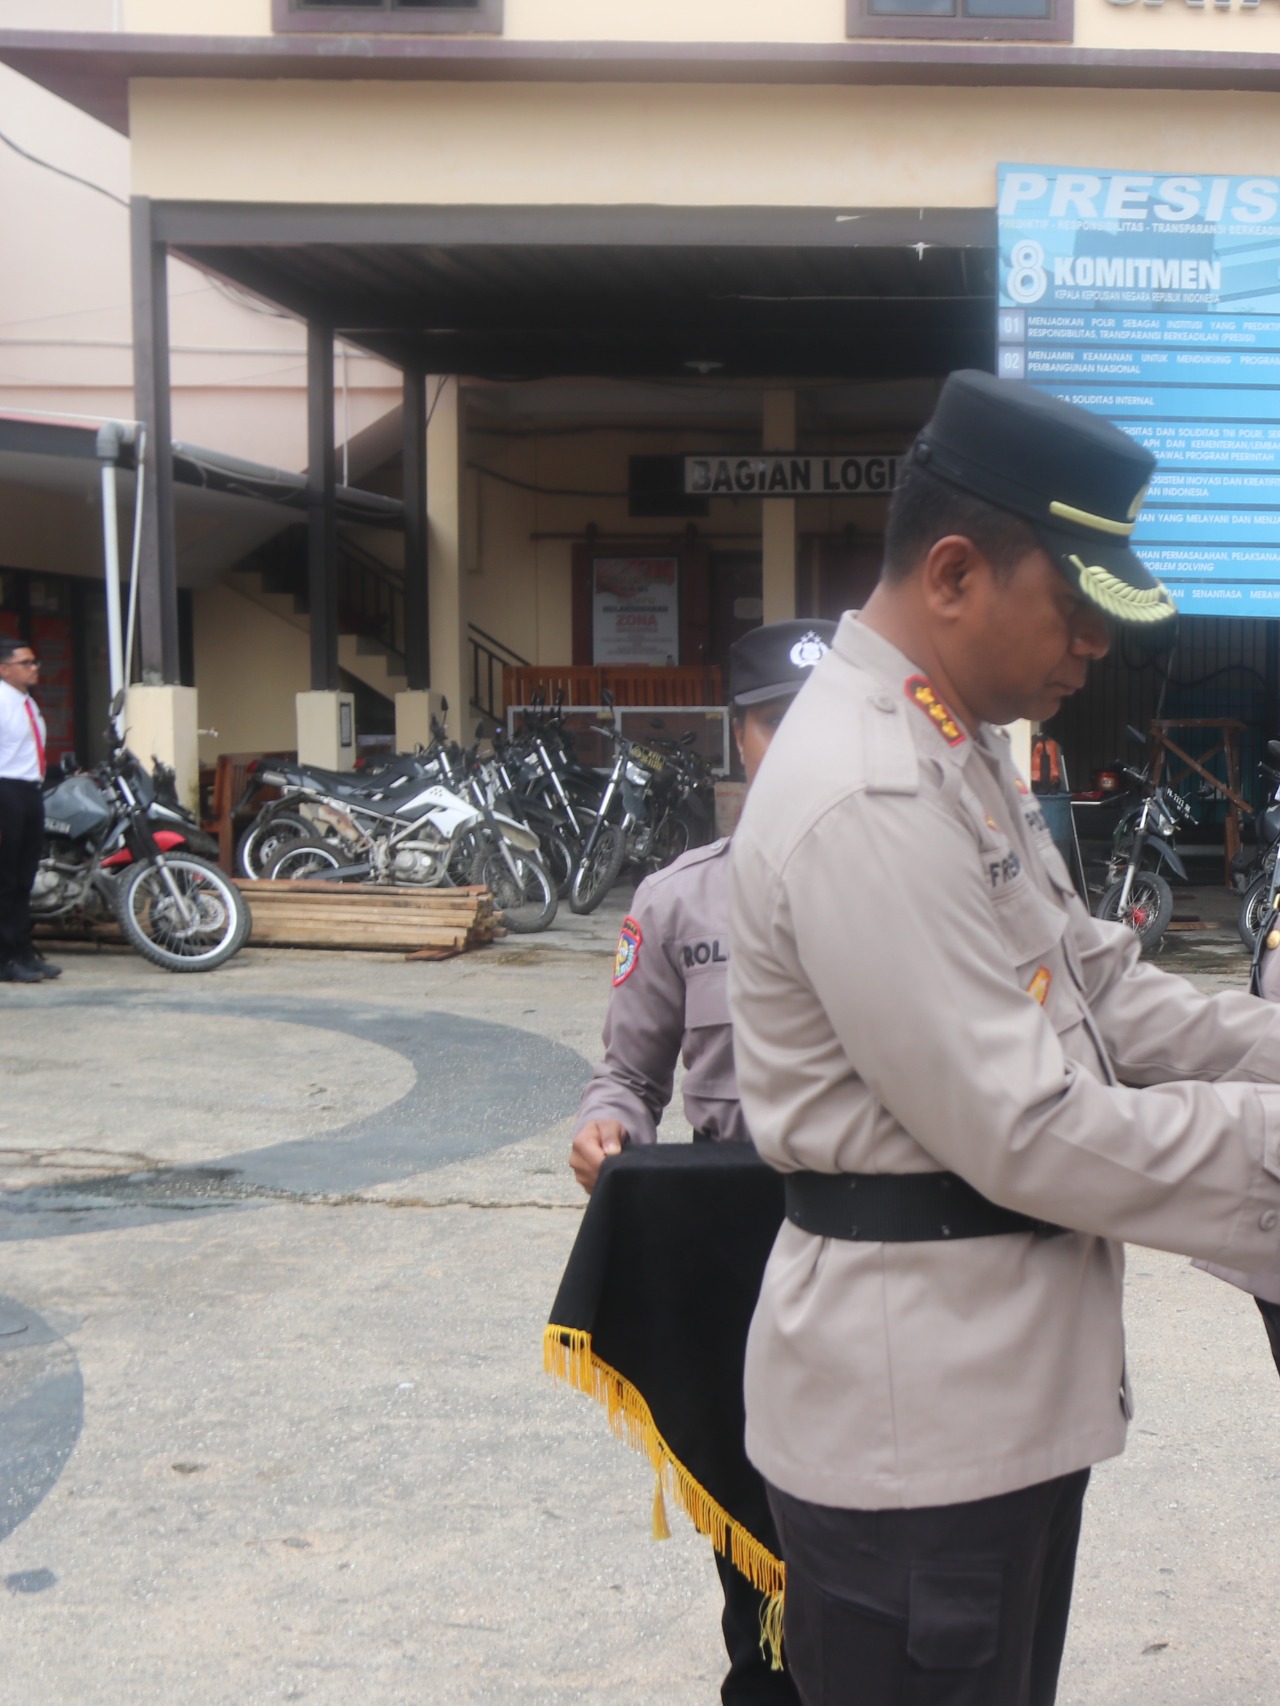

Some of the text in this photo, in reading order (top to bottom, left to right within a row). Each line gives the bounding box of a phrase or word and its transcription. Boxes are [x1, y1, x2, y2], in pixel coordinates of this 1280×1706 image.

[1057, 220, 1144, 232] RESPONSIBILITAS
[1152, 222, 1227, 234] TRANSPARANSI
[1007, 239, 1047, 303] 8
[1054, 256, 1221, 290] KOMITMEN
[1054, 289, 1081, 300] KEPALA
[1121, 291, 1150, 302] NEGARA
[1004, 317, 1019, 333] 01
[1027, 317, 1084, 326] MENJADIKAN
[1091, 318, 1115, 327] POLRI
[1122, 319, 1159, 328] SEBAGAI
[1167, 320, 1203, 329] INSTITUSI
[1210, 321, 1236, 330] YANG
[1100, 329, 1161, 340] TRANSPARANSI
[1163, 331, 1219, 341] BERKEADILAN
[1004, 353, 1019, 369] 02
[1027, 351, 1074, 360] MENJAMIN
[1082, 352, 1133, 361] KEAMANAN
[1141, 353, 1168, 363] UNTUK
[1177, 354, 1232, 364] MENDUKUNG
[1027, 362, 1141, 374] PEMBANGUNAN NASIONAL
[1072, 394, 1114, 404] SOLIDITAS
[1115, 395, 1154, 405] INTERNAL
[1156, 427, 1175, 437] DAN
[1178, 428, 1220, 437] SOLIDITAS
[1223, 428, 1235, 438] TNI
[1142, 439, 1160, 448] APH
[1166, 439, 1185, 448] DAN
[1185, 451, 1229, 461] PROGRAM
[691, 458, 896, 491] BAGIAN LOGI
[1186, 476, 1221, 486] INOVASI
[1222, 477, 1242, 486] DAN
[1162, 488, 1209, 497] INDONESIA
[1158, 513, 1184, 523] YANG
[1186, 514, 1229, 524] MELAYANI
[1231, 515, 1251, 524] DAN
[1177, 562, 1215, 571] SOLVING
[1192, 589, 1242, 599] SENANTIASA
